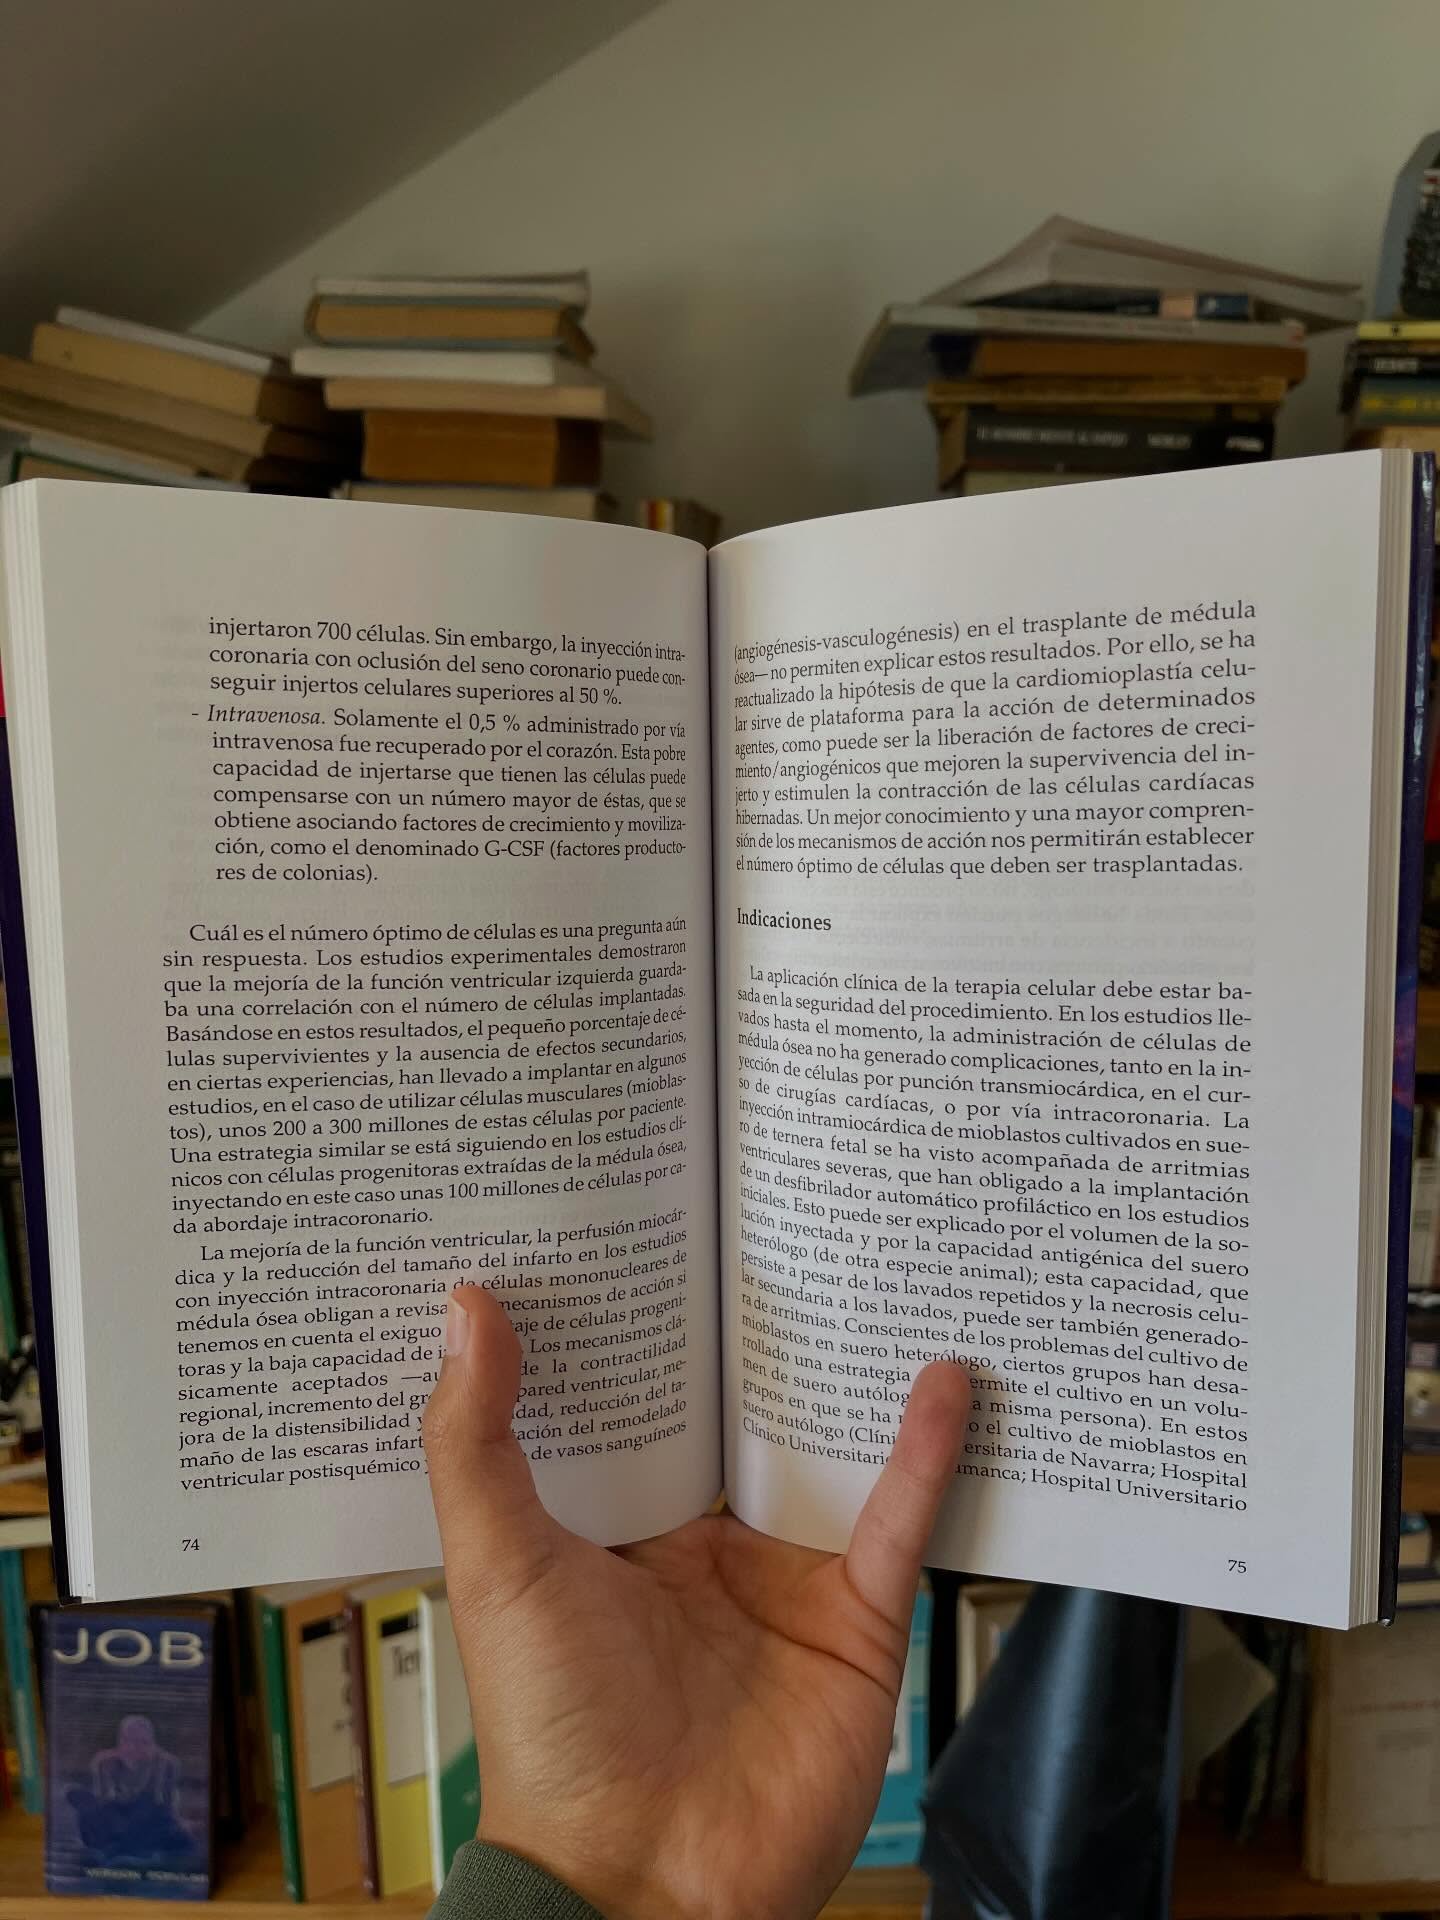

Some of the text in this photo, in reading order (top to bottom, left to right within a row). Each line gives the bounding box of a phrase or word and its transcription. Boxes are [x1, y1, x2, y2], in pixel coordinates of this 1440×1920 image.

[209, 617, 685, 662] injertaron 700 células. Sin embargo, la inyección intra-
[735, 600, 1256, 664] (angiogénesis-vasculogénesis) en el trasplante de médula
[208, 704, 686, 742] Intravenosa. Solamente el 0,5 % administrado por vía
[736, 744, 1254, 782] miento/angiogénicos que mejoren la supervivencia del in-
[214, 810, 686, 838] obtiene asociando factores de crecimiento y moviliza-
[216, 837, 686, 861] ción, como el denominado G-CSF (factores producto-
[736, 854, 1242, 879] el número óptimo de células que deben ser trasplantadas.
[216, 863, 378, 884] res de colonias).
[190, 916, 686, 946] Cuál es el número óptimo de células es una pregunta aún
[737, 908, 831, 930] Indicaciones
[750, 965, 1252, 1000] La aplicación clínica de la terapia celular debe estar ba-
[166, 1005, 686, 1042] Basándose en estos resultados, el pequeño porcentaje de cé-
[172, 1163, 686, 1215] inyectando en este caso unas 100 millones de células por ca-
[740, 1143, 1250, 1203] ventriculares severas, que han obligado a la implantación
[173, 1208, 432, 1234] da abordaje intracoronario.
[200, 1208, 686, 1263] La mejoría de la función ventricular, la perfusión miocár-
[741, 1225, 1248, 1304] heterólogo (de otra especie animal); esta capacidad, que
[178, 1325, 441, 1354] tenemos en cuenta el exiguo
[742, 1294, 1247, 1372] ra de arritmias. Conscientes de los problemas del cultivo de
[1032, 1468, 1246, 1510] Hospital Universitario
[182, 1538, 200, 1551] 74
[1228, 1560, 1246, 1573] 75
[53, 1628, 204, 1668] JOB
